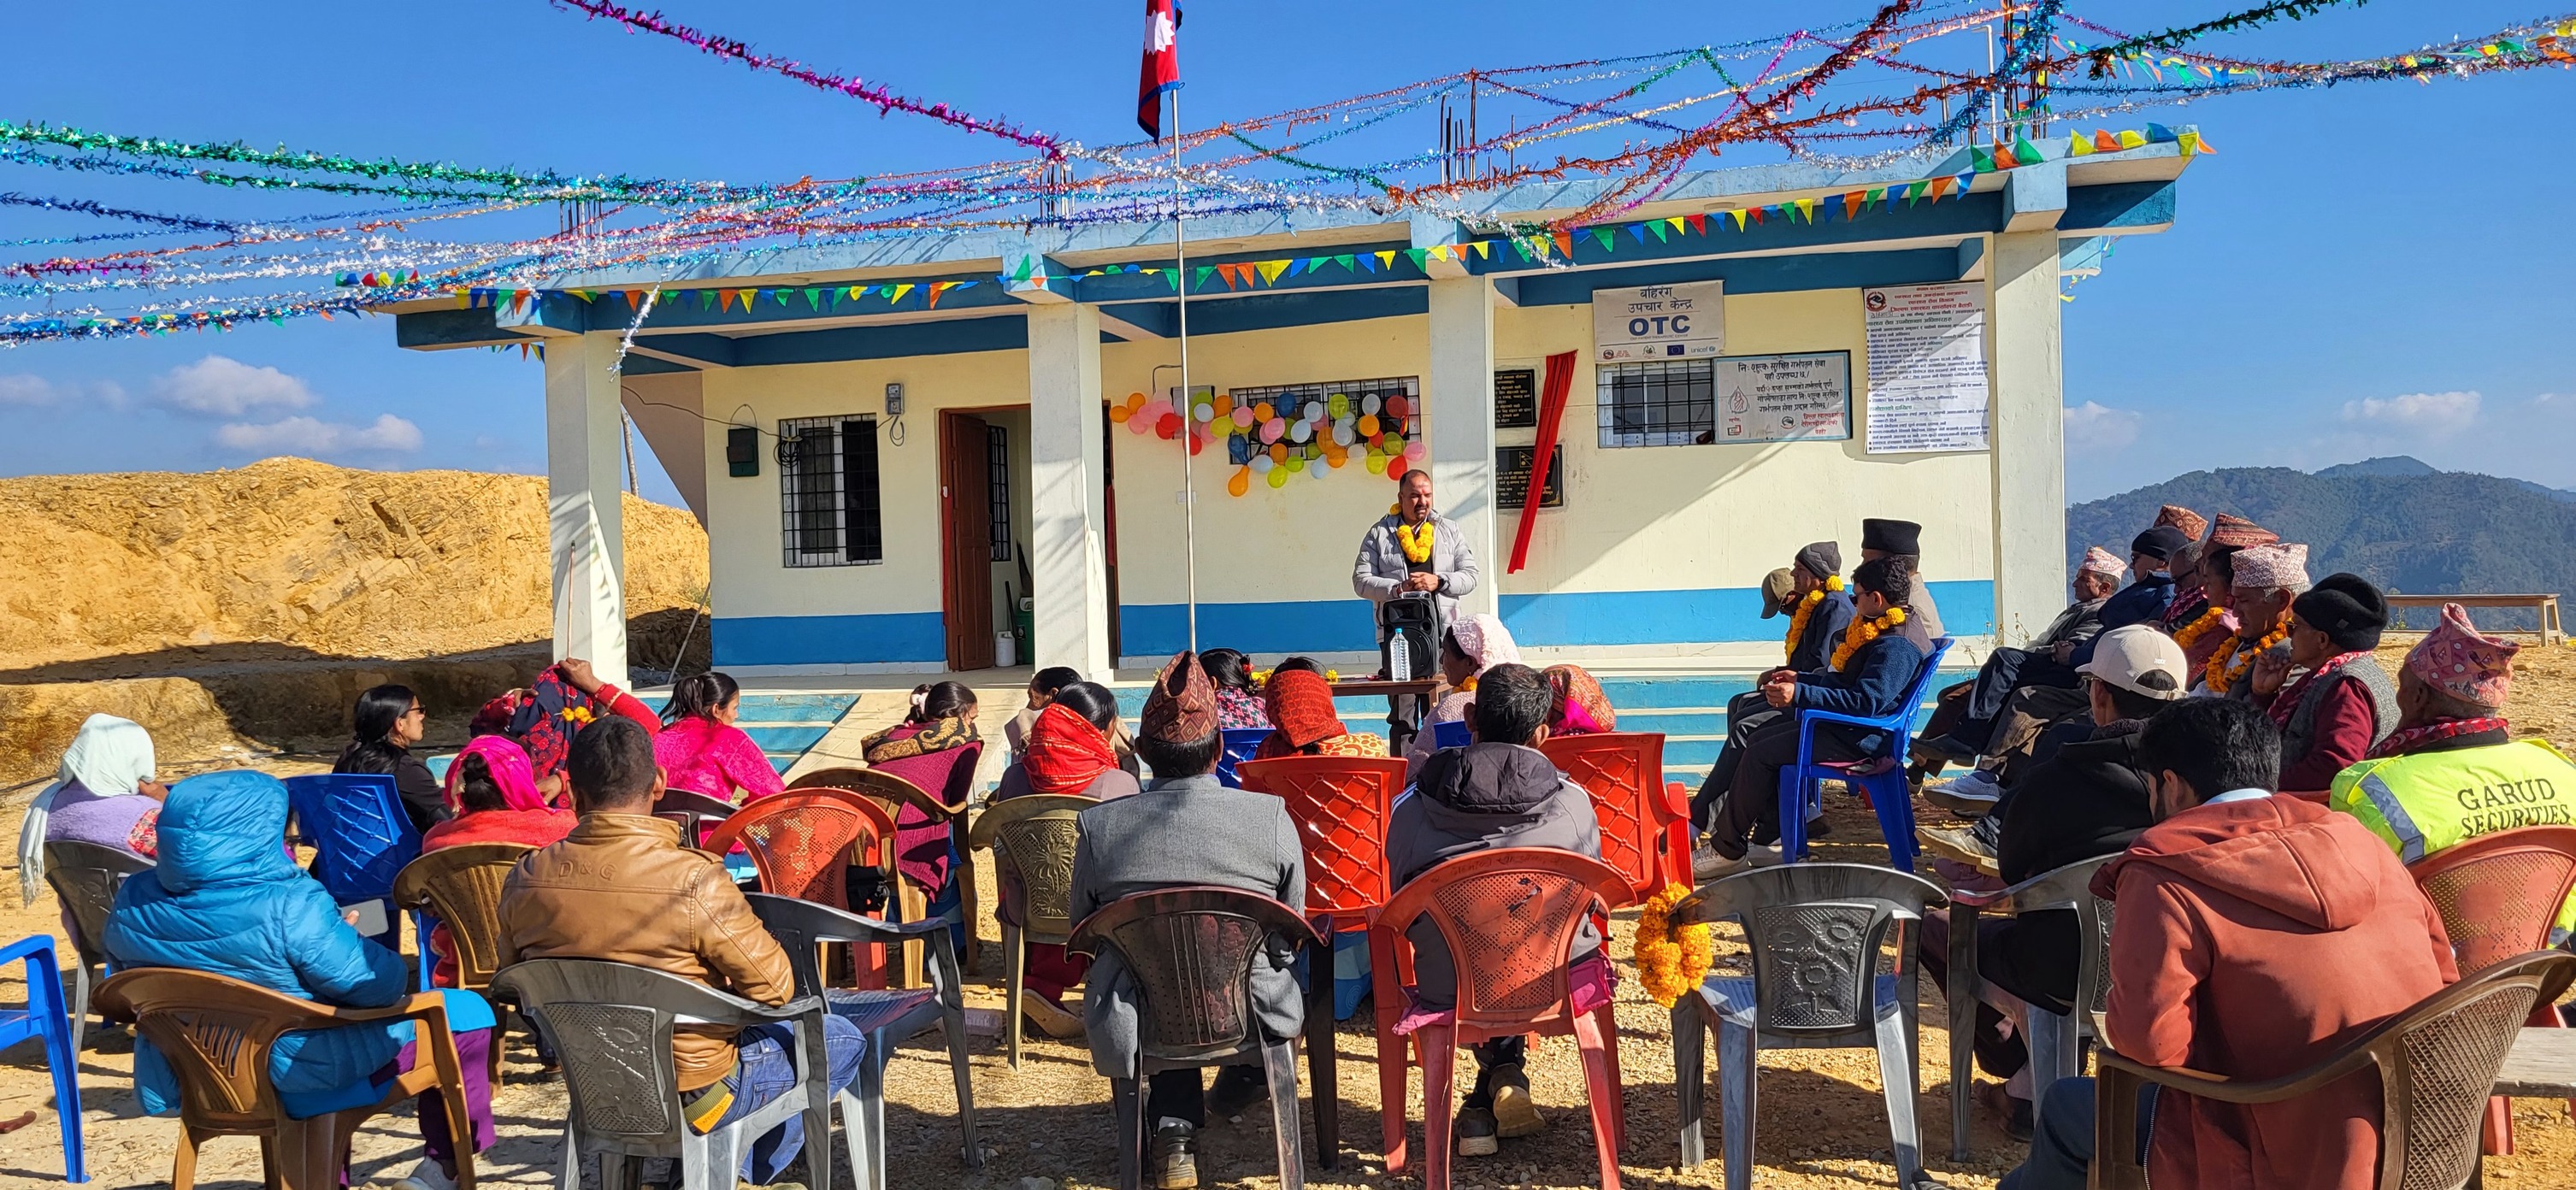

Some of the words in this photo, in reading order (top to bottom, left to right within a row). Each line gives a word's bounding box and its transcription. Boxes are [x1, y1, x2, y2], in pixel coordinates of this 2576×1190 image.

[1628, 301, 1663, 313] उपचार
[1670, 297, 1693, 310] केन्द्र
[1629, 315, 1690, 336] OTC
[1814, 357, 1826, 368] सेवा
[2456, 778, 2555, 810] GARUD
[2461, 804, 2571, 838] SECURITIES
